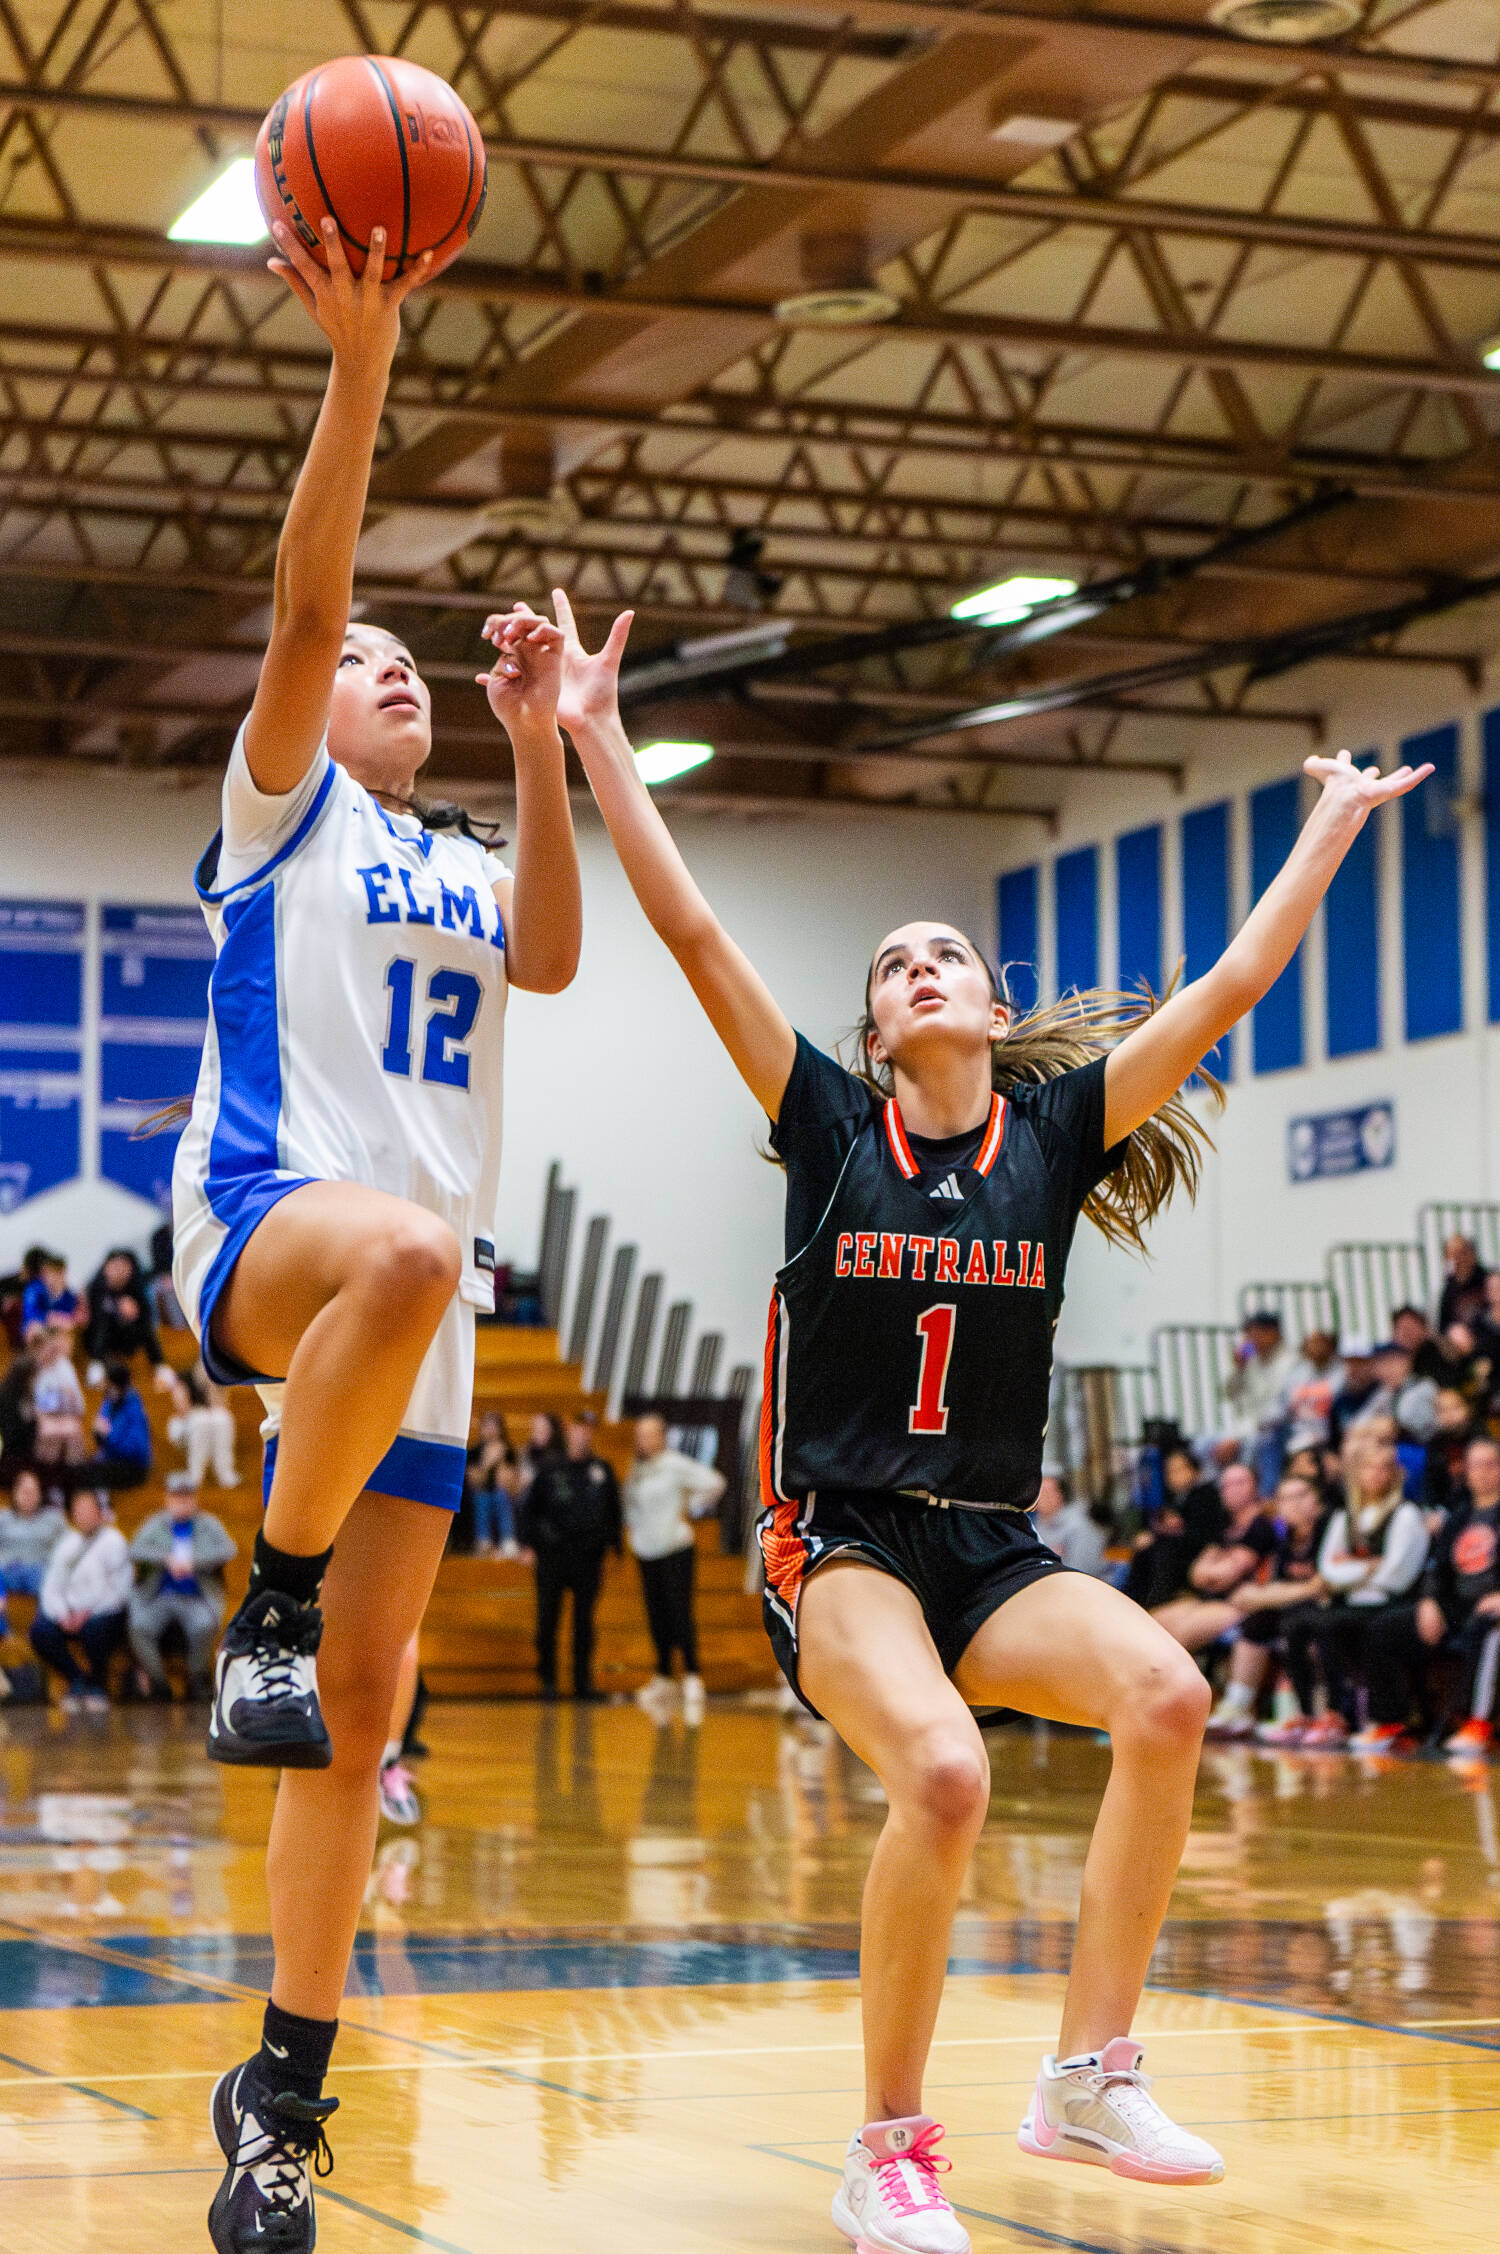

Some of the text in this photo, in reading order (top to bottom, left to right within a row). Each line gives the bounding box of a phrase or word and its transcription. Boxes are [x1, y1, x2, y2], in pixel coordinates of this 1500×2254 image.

[380, 954, 485, 1094] 12
[835, 1232, 1046, 1289] CENTRALIA
[908, 1303, 957, 1435] 1
